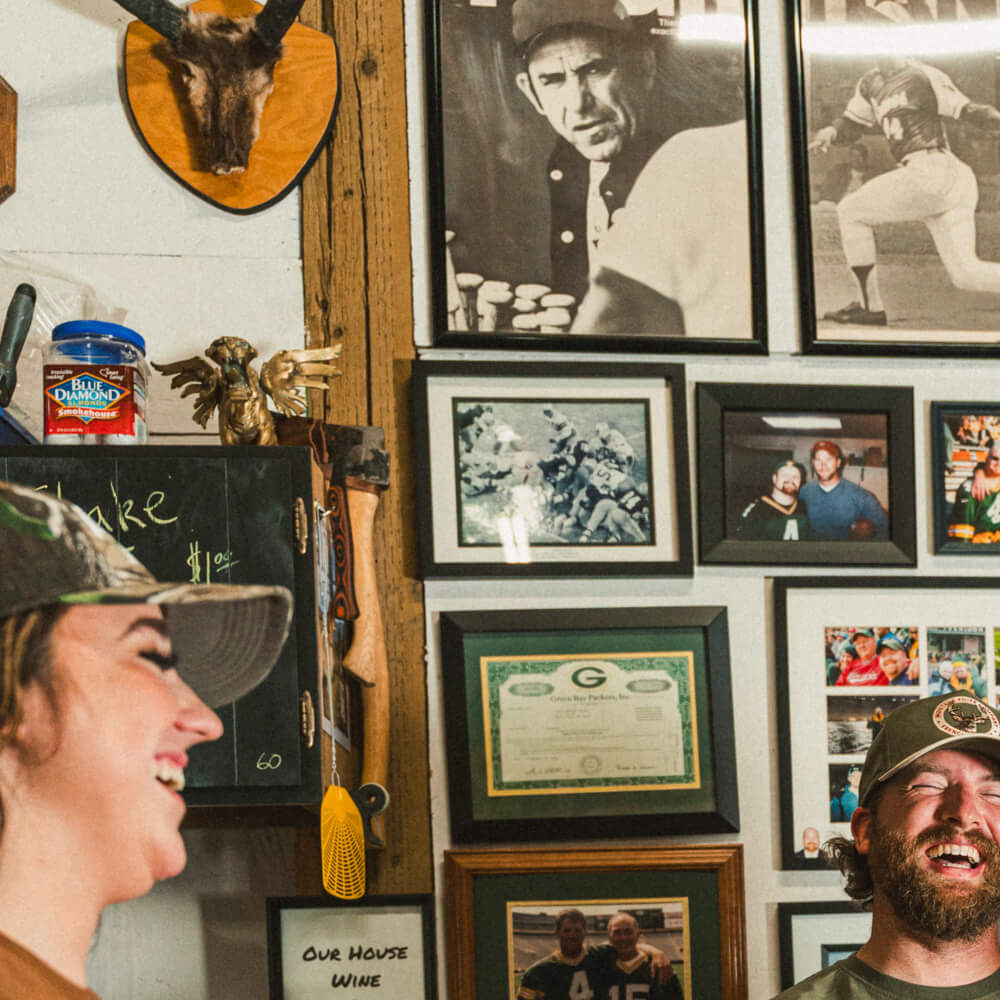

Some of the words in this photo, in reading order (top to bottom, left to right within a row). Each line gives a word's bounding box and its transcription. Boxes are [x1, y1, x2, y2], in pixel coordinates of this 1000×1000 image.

[71, 378, 104, 392] BLUE
[54, 388, 121, 402] DIAMOND
[571, 666, 608, 689] G
[256, 751, 282, 770] 60
[302, 945, 342, 962] OUR
[348, 945, 409, 961] HOUSE
[331, 973, 382, 989] WINE
